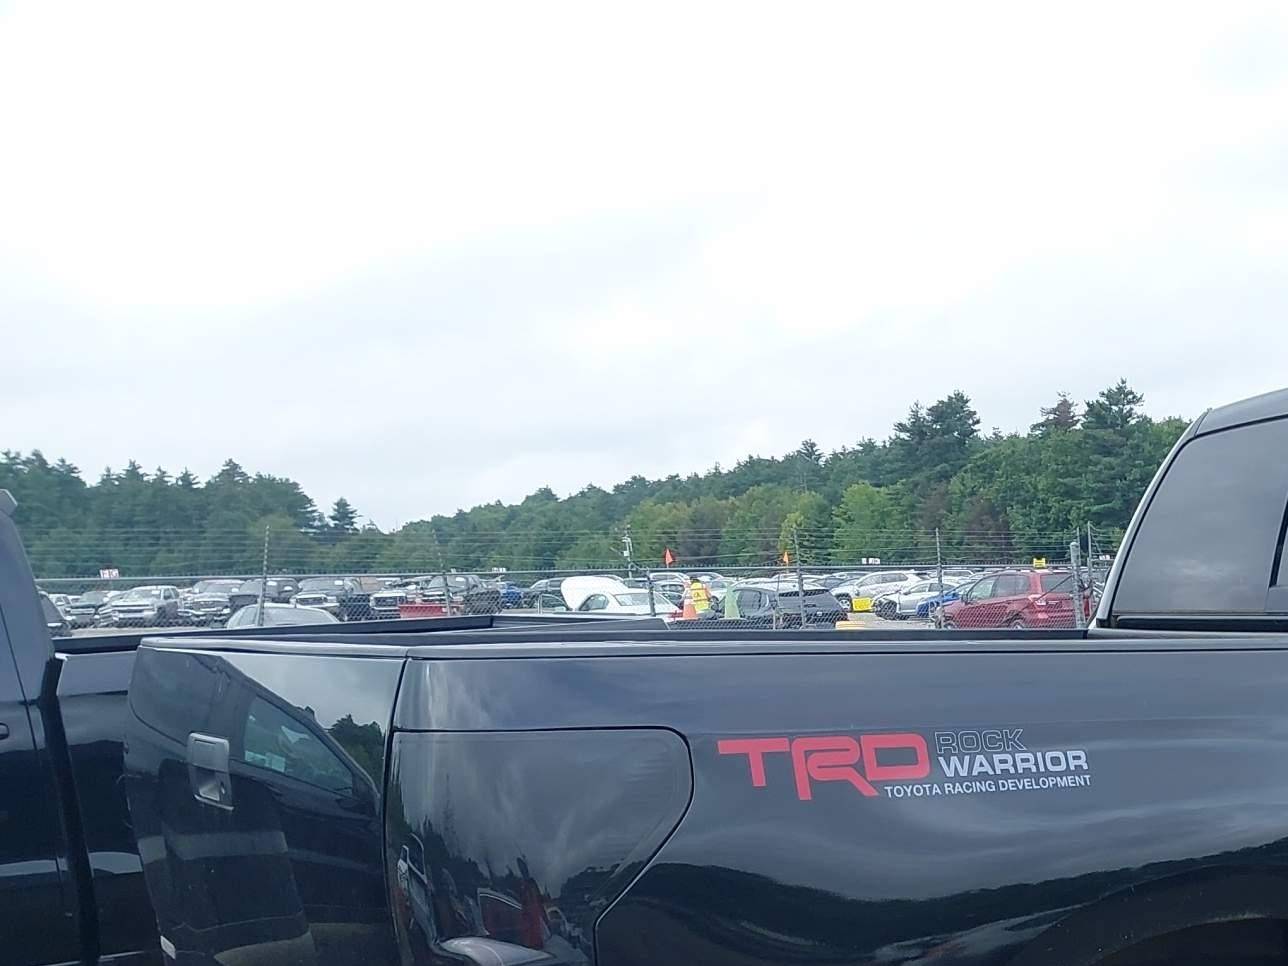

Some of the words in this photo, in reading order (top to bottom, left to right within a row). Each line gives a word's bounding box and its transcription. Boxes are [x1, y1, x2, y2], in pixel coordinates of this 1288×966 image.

[934, 729, 1026, 754] ROCK
[717, 734, 930, 800] TRD
[937, 750, 1089, 777] WARRIOR
[884, 784, 942, 799] TOYOTA
[944, 779, 996, 795] RACING
[999, 774, 1092, 792] DEVELOPMENT
